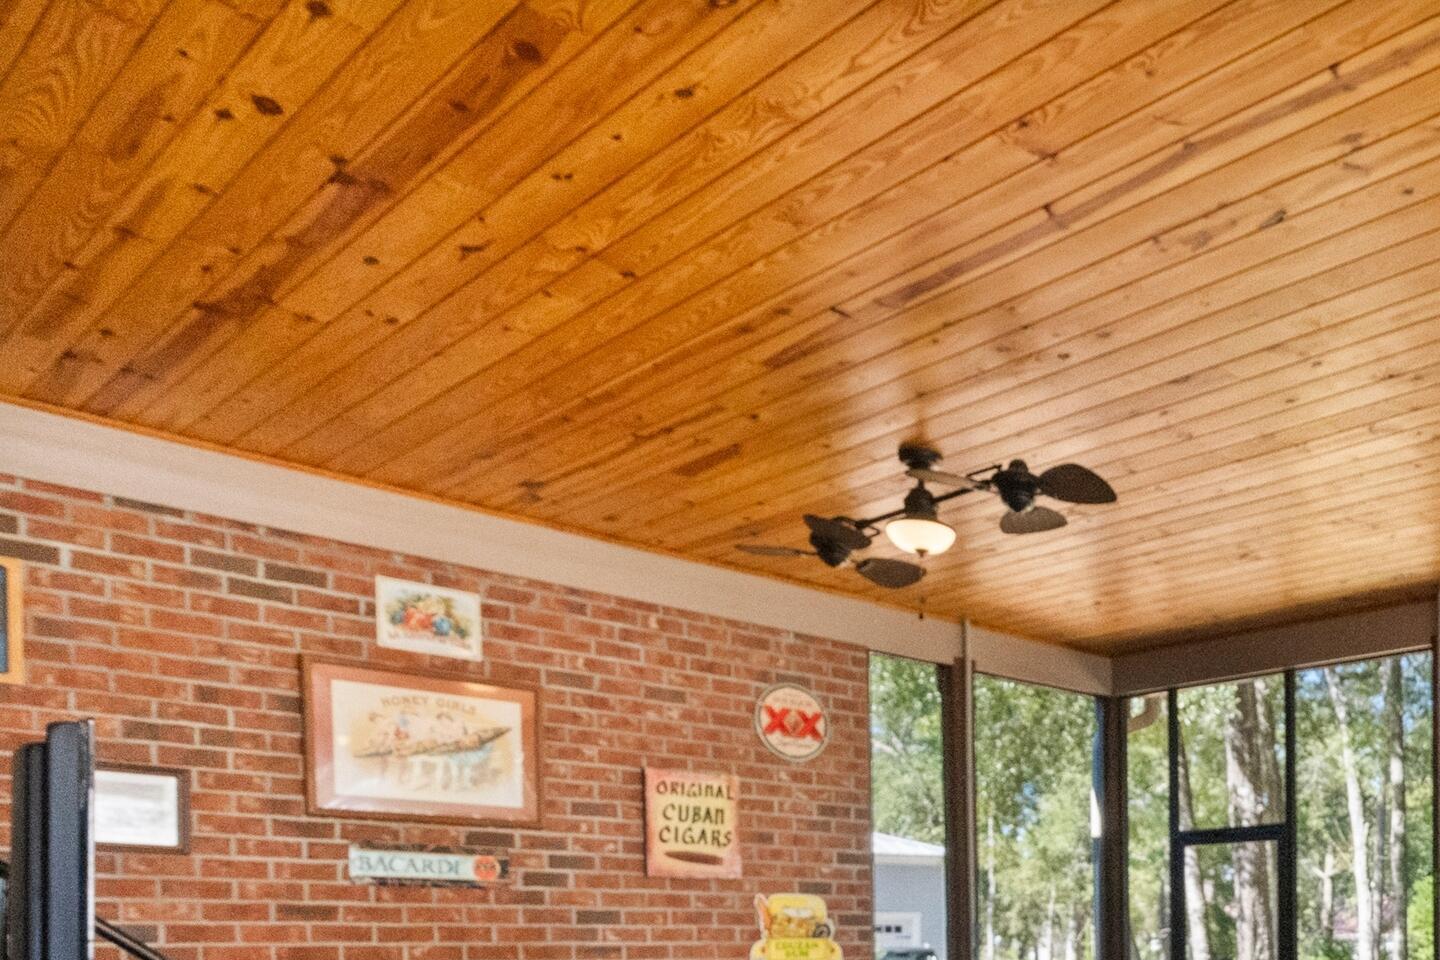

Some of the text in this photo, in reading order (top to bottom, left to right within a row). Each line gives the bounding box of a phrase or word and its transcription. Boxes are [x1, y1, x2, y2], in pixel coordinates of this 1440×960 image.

[656, 780, 734, 801] ORIGINAL
[663, 804, 725, 825] CUBAN
[659, 826, 732, 848] CIGARS
